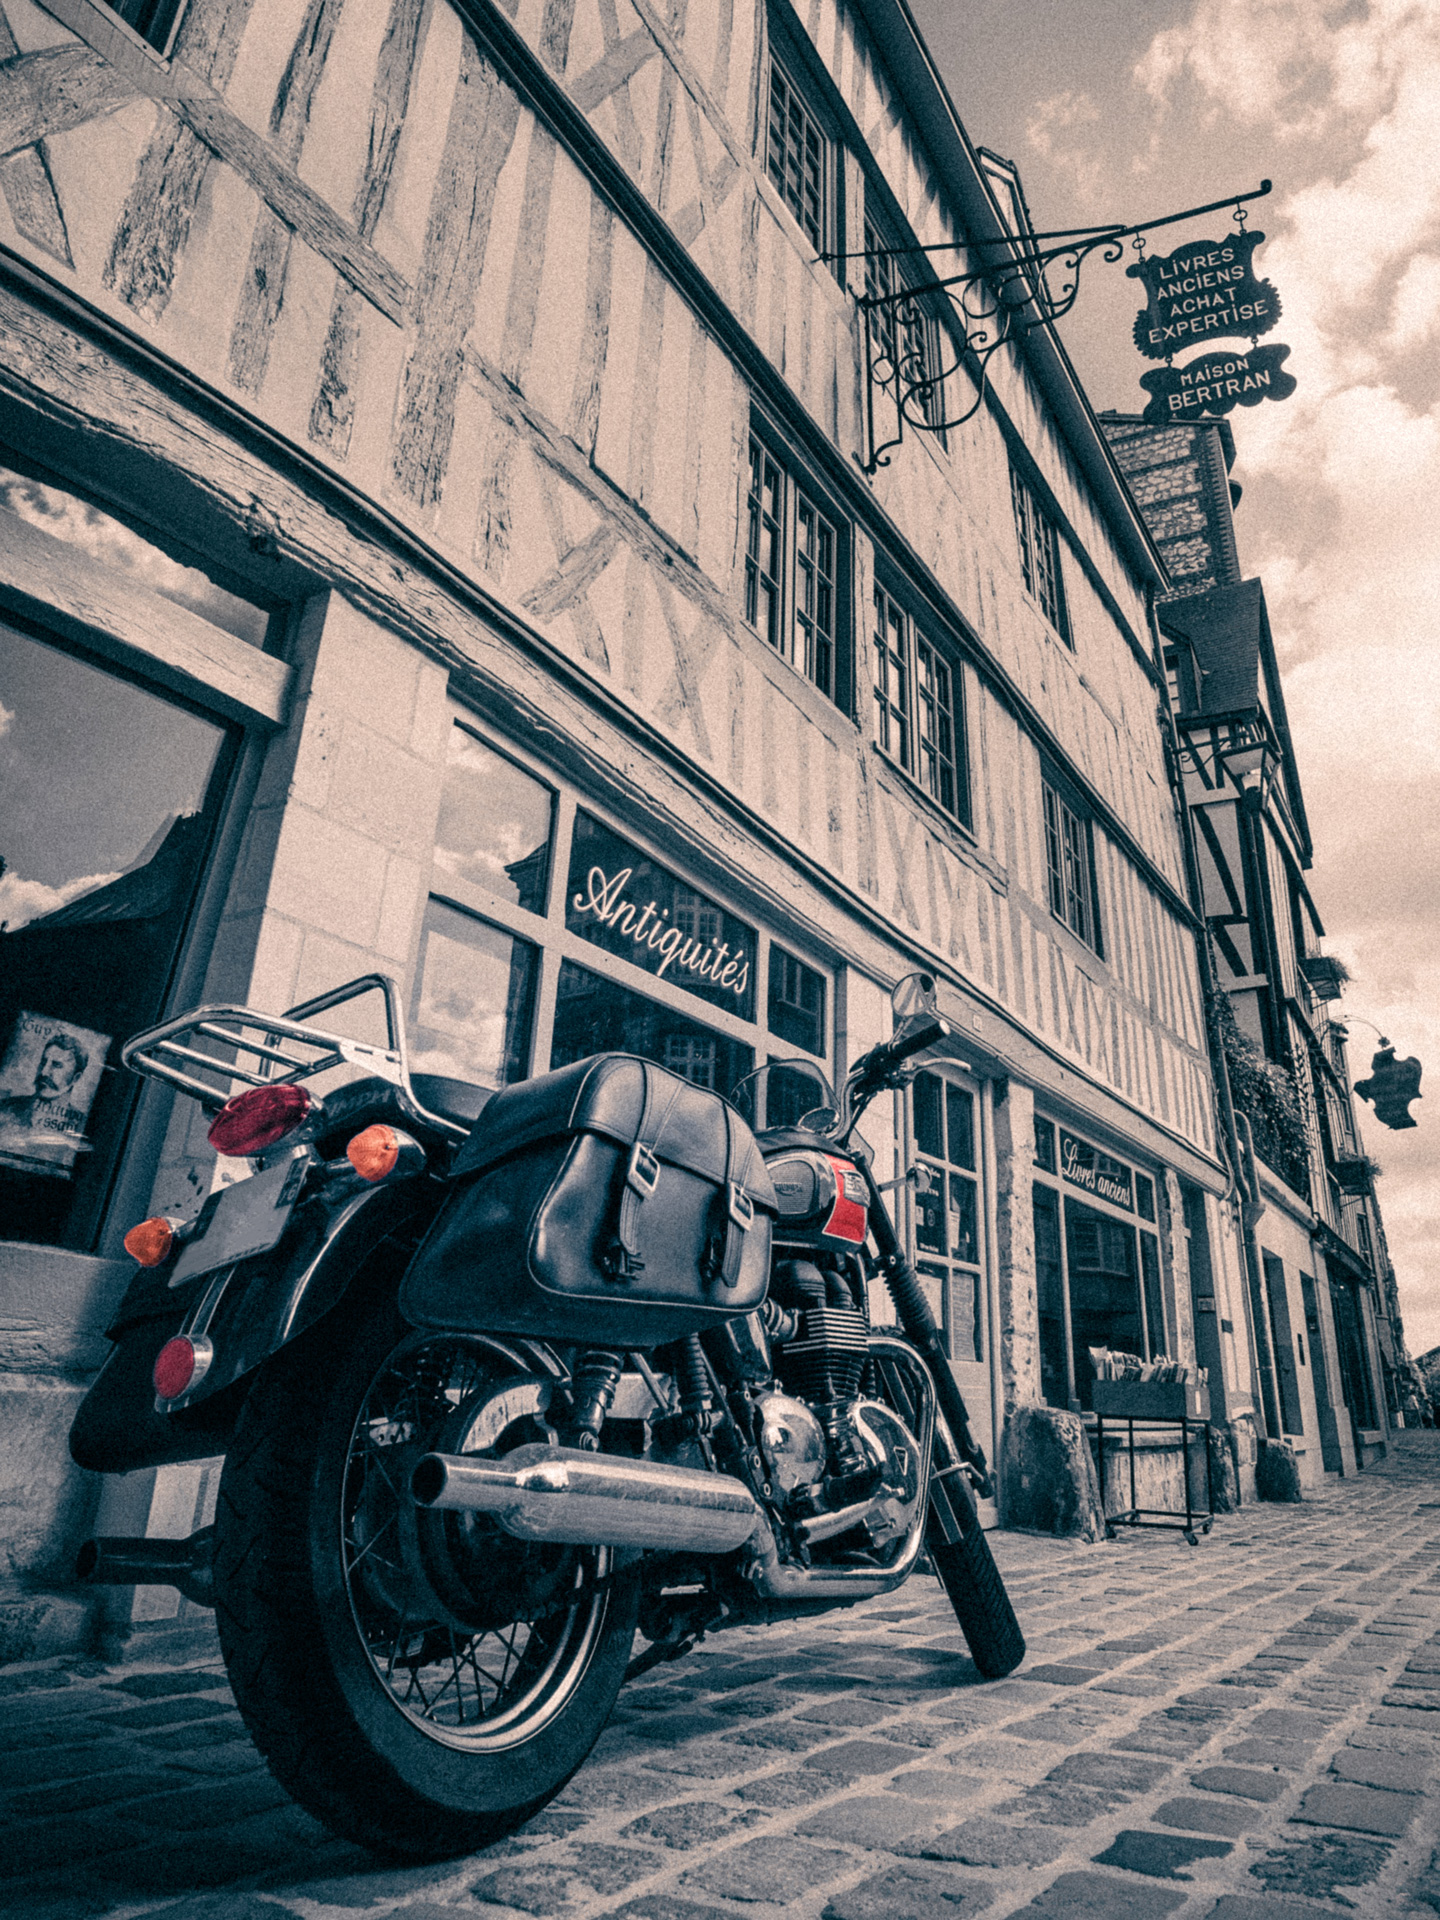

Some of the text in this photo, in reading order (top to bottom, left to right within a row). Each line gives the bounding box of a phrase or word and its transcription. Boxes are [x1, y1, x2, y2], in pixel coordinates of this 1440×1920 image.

[1170, 287, 1237, 317] ACHAT
[1169, 370, 1271, 411] BERTRAN
[573, 866, 749, 994] Antiquités
[1062, 1138, 1130, 1206] Livres anciens
